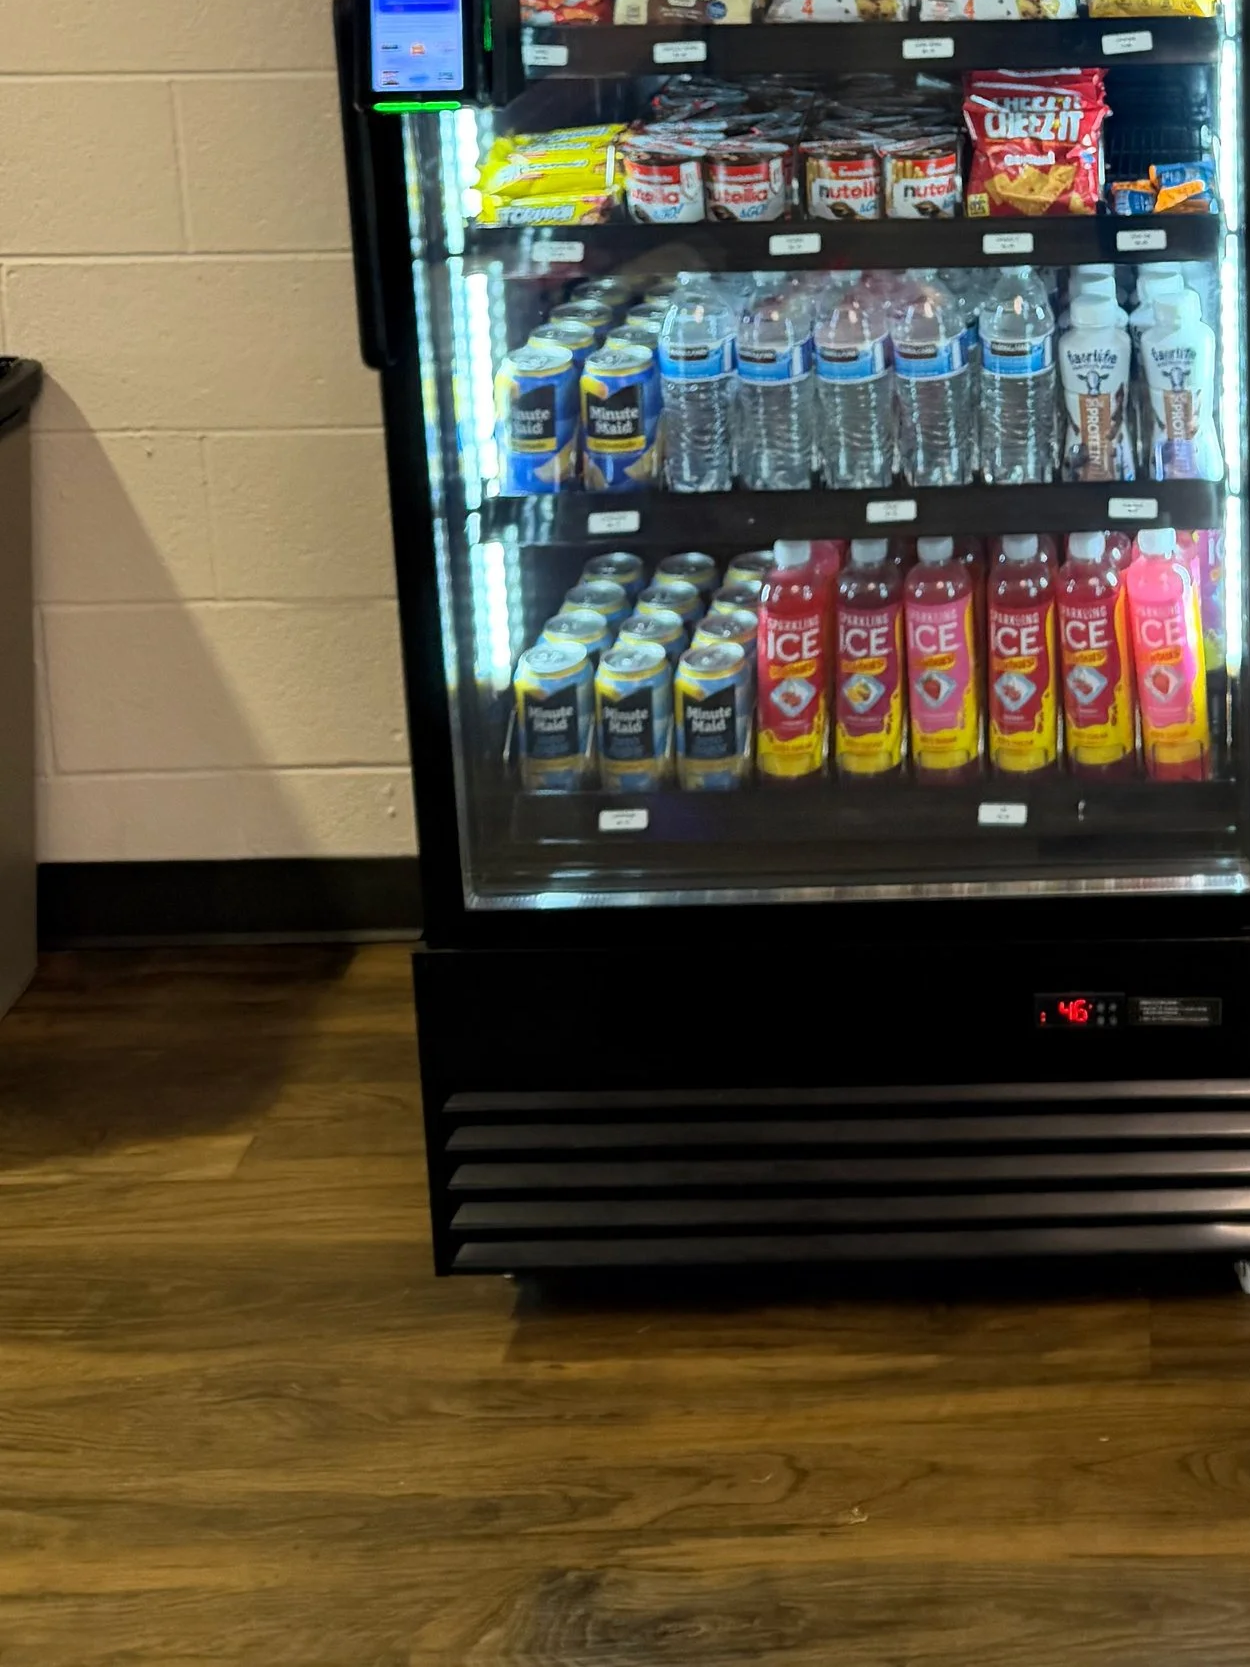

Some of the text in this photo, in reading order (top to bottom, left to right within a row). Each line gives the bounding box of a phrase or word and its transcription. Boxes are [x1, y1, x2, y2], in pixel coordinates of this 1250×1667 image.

[589, 405, 640, 422] Minute
[595, 420, 634, 436] Maid
[1086, 407, 1102, 467] PROTEIN
[766, 628, 822, 662] ICE
[840, 626, 893, 658] ICE
[908, 621, 962, 655] ICE
[990, 622, 1045, 657] ICE
[528, 706, 575, 719] Minute
[604, 706, 650, 720] Minute
[686, 705, 733, 719] Minute
[533, 718, 569, 733] Maid
[608, 719, 644, 734] Maid
[691, 718, 727, 733] Maid
[1058, 999, 1088, 1023] 46
